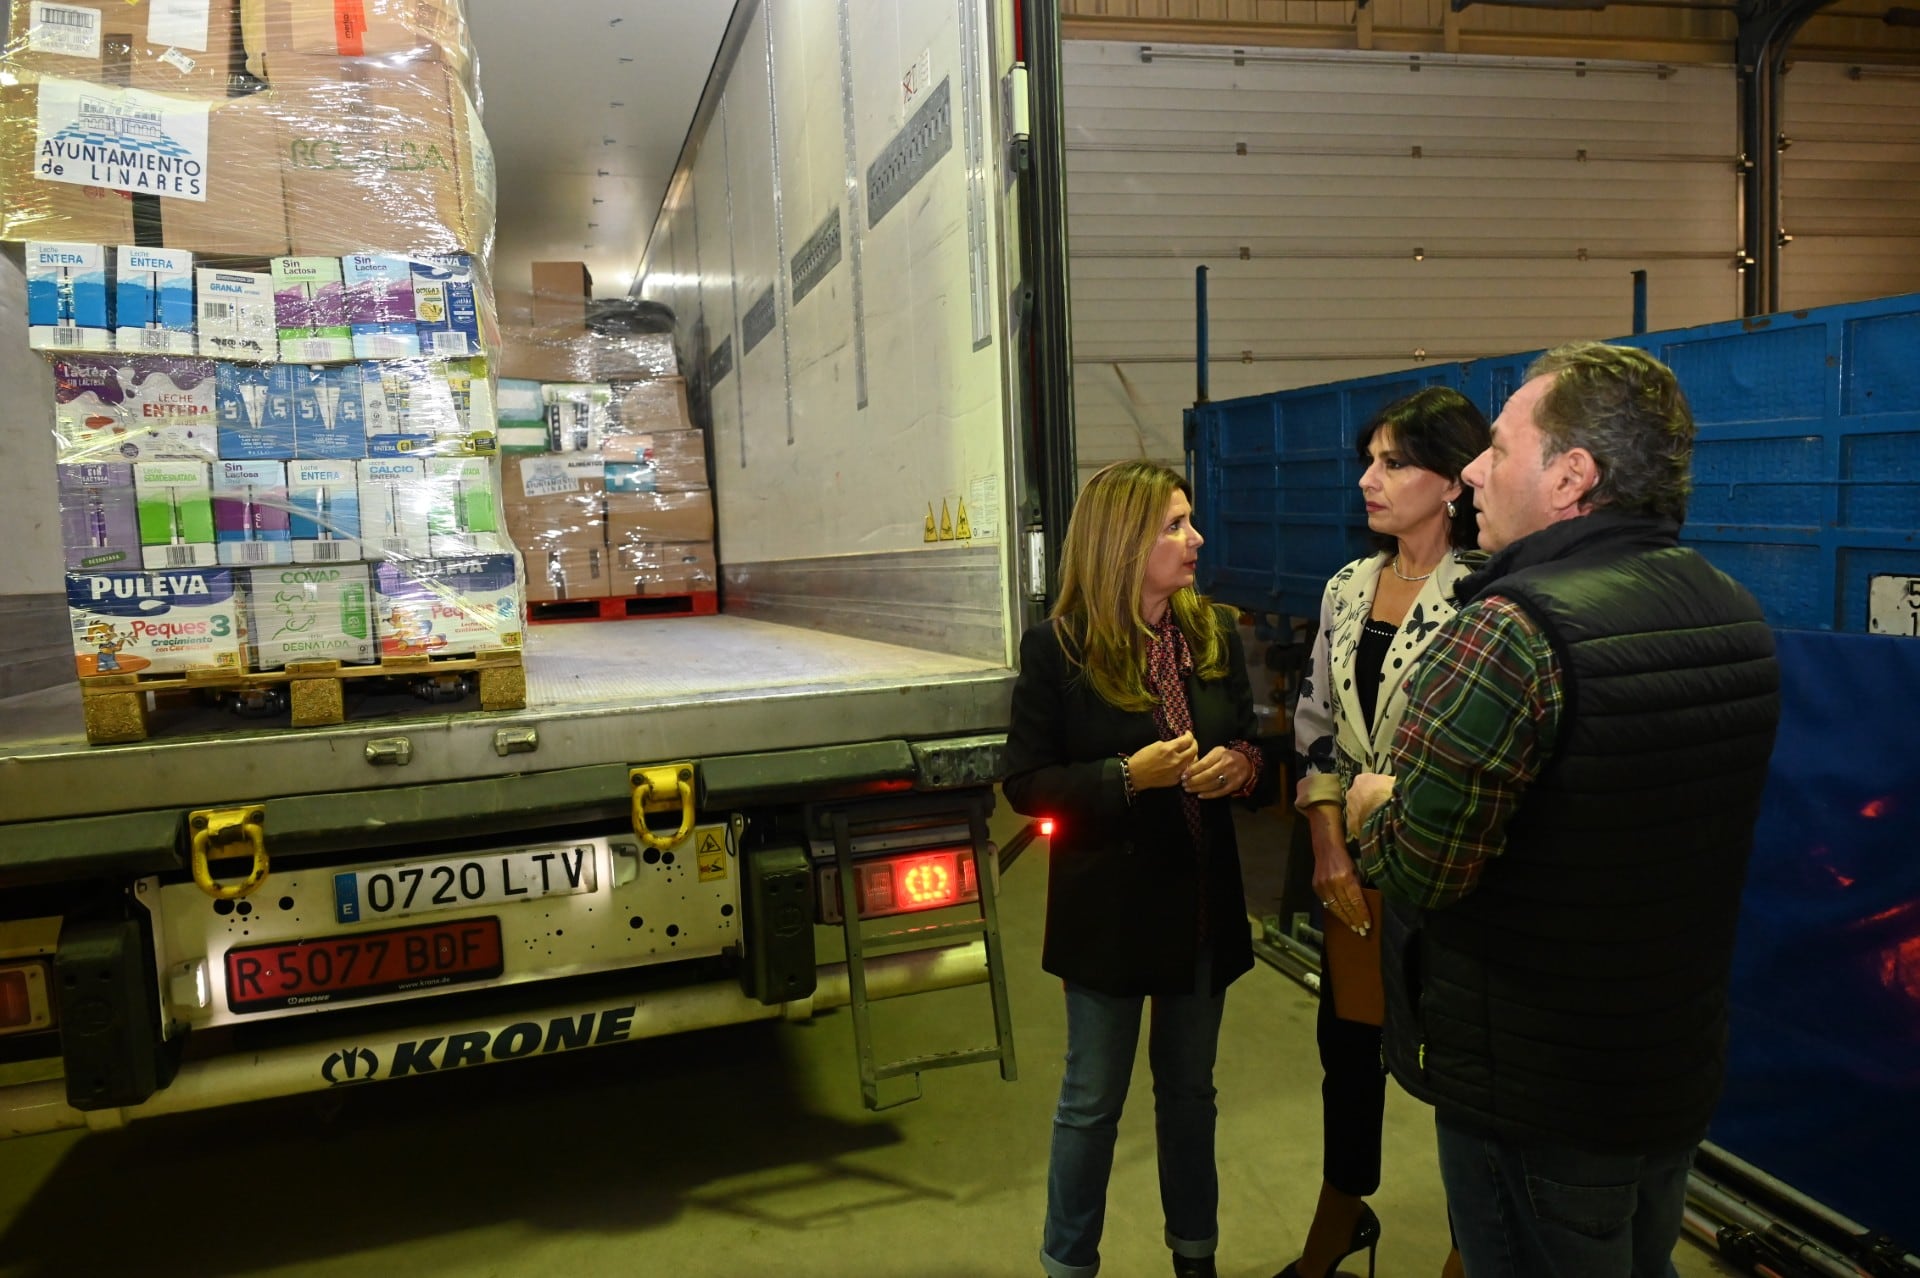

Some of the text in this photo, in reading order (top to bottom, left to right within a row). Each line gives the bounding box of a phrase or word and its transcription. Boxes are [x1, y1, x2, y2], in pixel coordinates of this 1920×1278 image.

[42, 140, 200, 176] AYUNTAMIENTO
[41, 159, 64, 176] de
[92, 170, 200, 195] LINARES
[40, 254, 83, 265] ENTERA
[131, 258, 173, 269] ENTERA
[283, 259, 300, 268] Sin
[354, 256, 371, 265] Sin
[210, 283, 242, 294] GRANJA
[158, 393, 193, 402] LECHE
[143, 403, 209, 417] ENTERA
[224, 463, 243, 471] Sin
[369, 465, 414, 473] CALCIO
[301, 471, 340, 480] ENTERA
[280, 570, 341, 584] COVAP
[91, 575, 209, 600] PULEVA
[131, 620, 208, 640] Peques
[209, 614, 231, 637] 3
[151, 636, 213, 647] Crecimiento
[282, 640, 351, 652] DESNATADA
[367, 848, 584, 913] 0720 LTV
[343, 903, 353, 915] E
[236, 928, 484, 997] R 5077 BDF
[388, 1006, 636, 1078] KRONE
